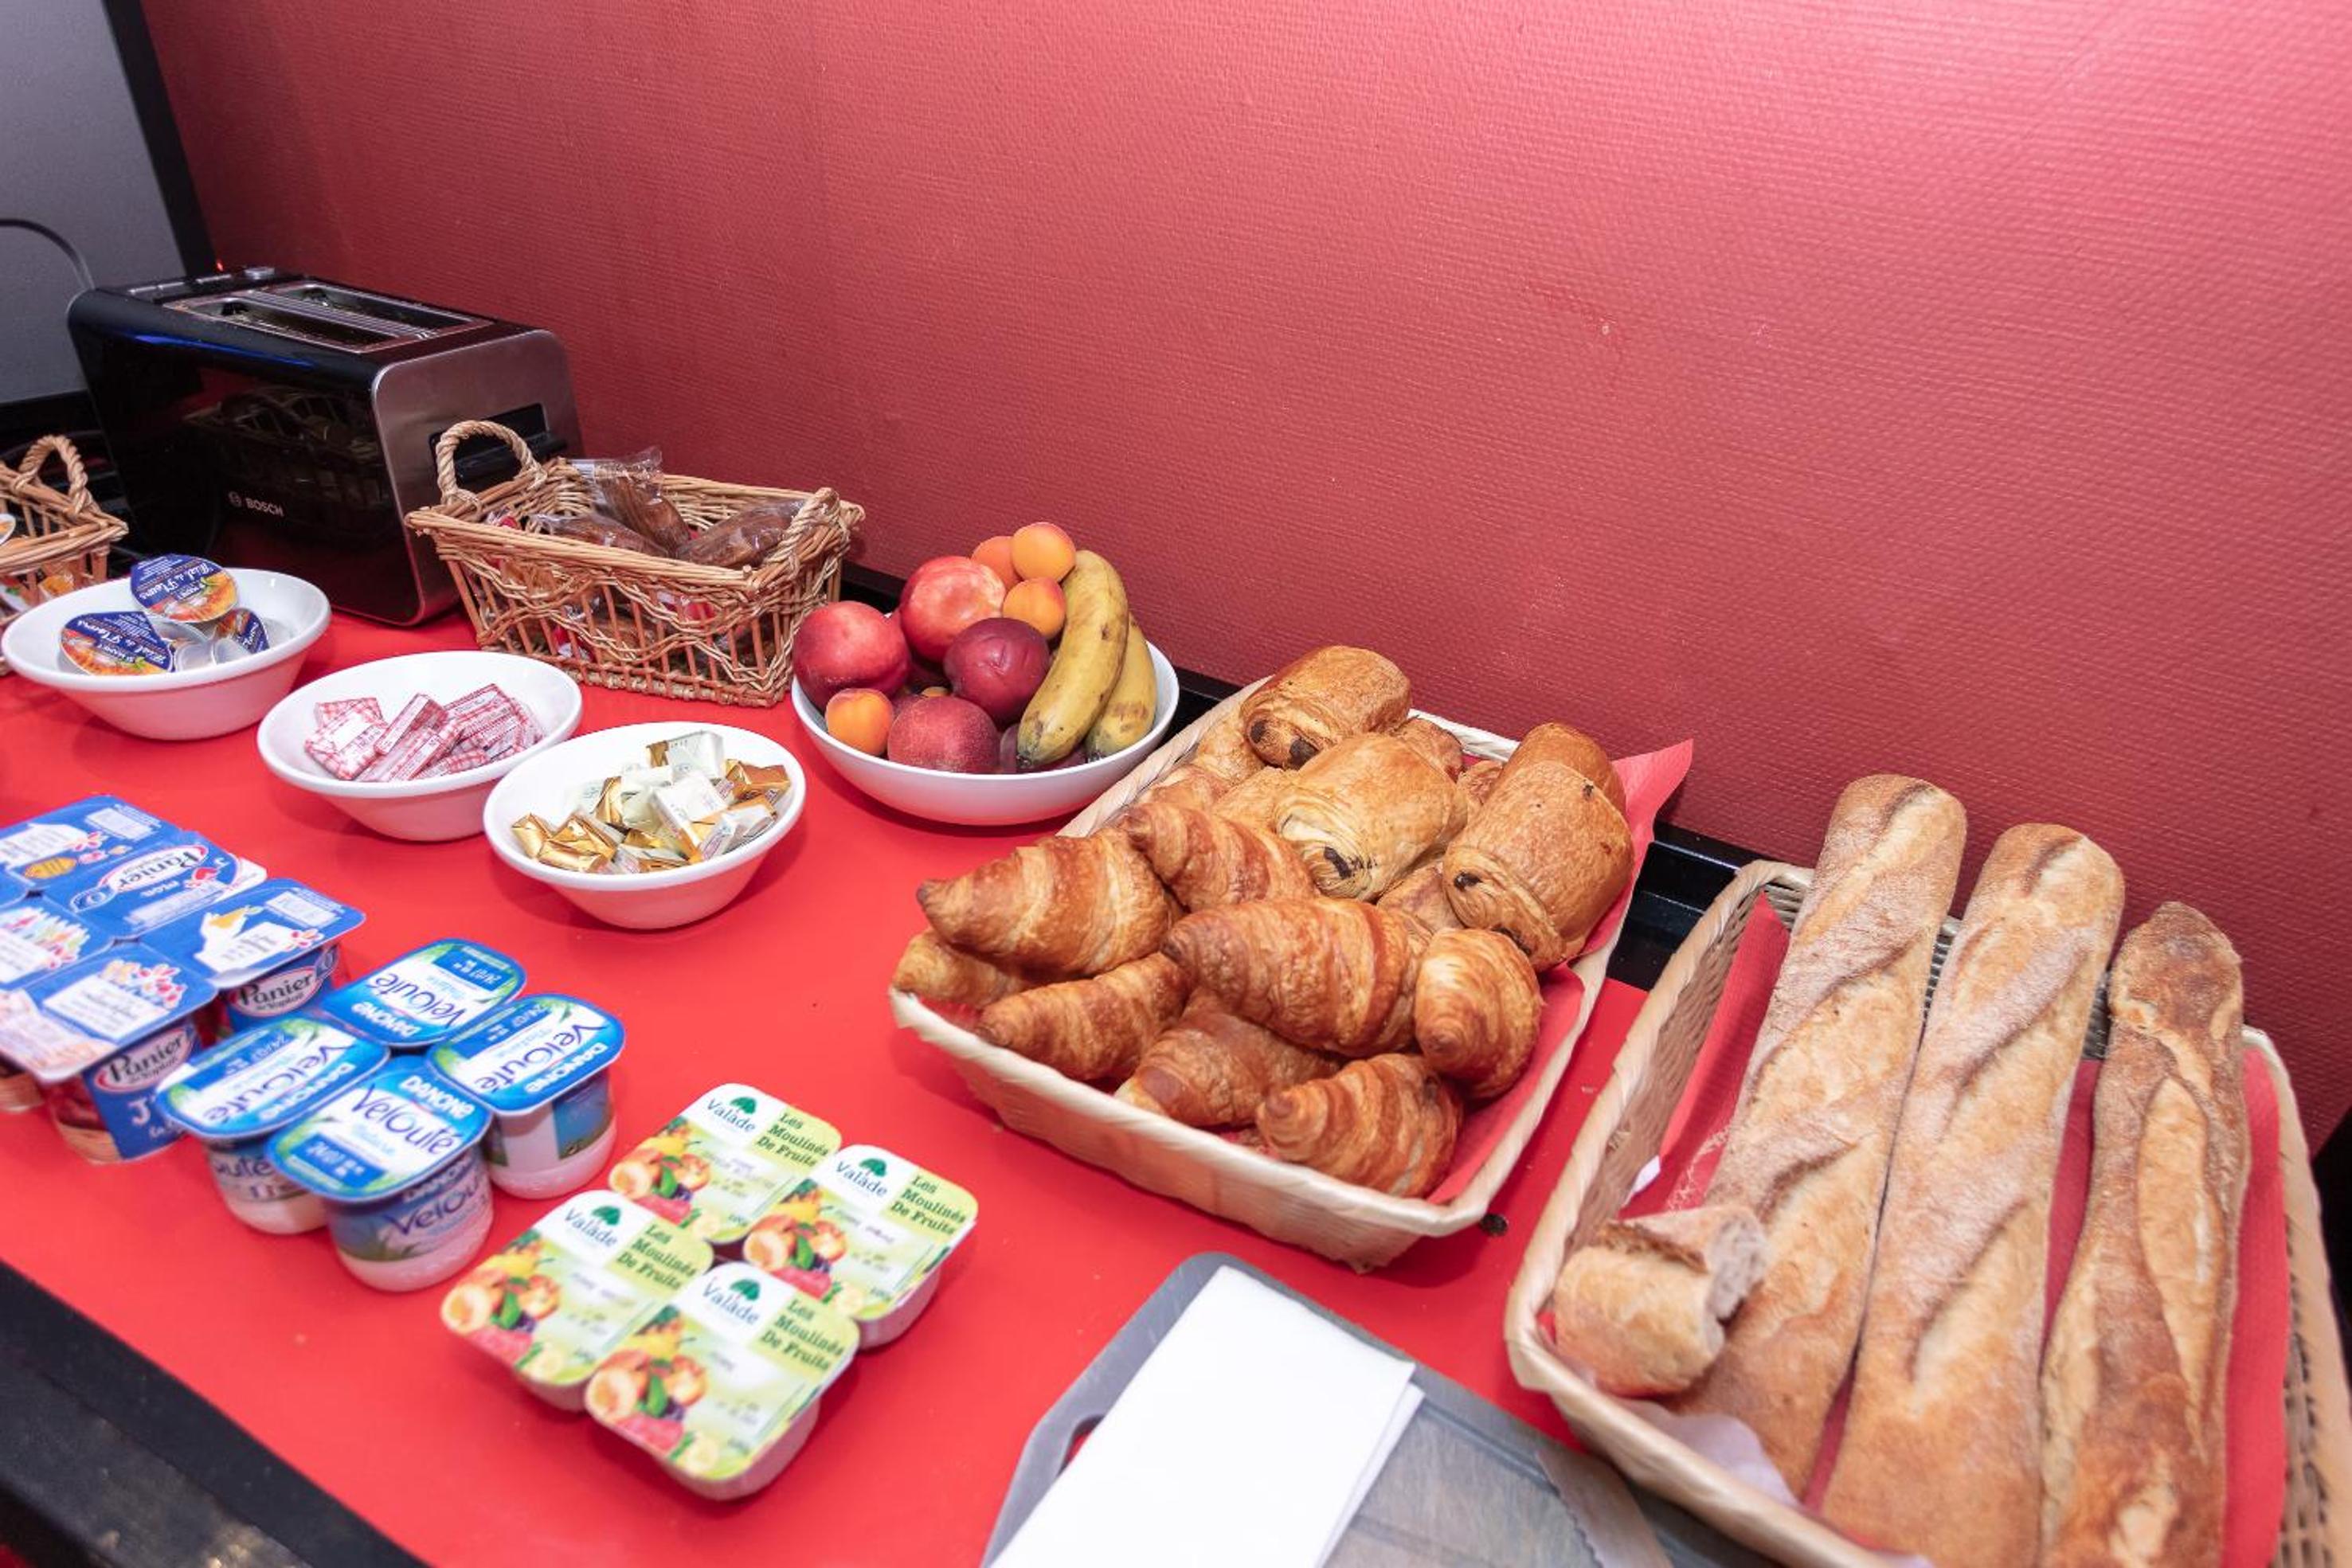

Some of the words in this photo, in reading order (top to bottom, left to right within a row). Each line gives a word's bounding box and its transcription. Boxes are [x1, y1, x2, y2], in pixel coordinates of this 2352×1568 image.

[245, 497, 284, 518] BOSCH
[118, 850, 199, 887] Panier
[240, 973, 314, 1007] Panier
[109, 1037, 182, 1082] Panier
[707, 1098, 755, 1132] Valade
[779, 1112, 804, 1129] Les
[757, 1136, 775, 1150] De
[775, 1145, 816, 1167] Fruits
[836, 1161, 888, 1197] Valade
[911, 1175, 937, 1194] Les
[890, 1201, 910, 1215] De
[911, 1211, 956, 1234] Fruits
[645, 1224, 671, 1245] Les
[637, 1263, 681, 1290] Fruits
[787, 1299, 815, 1321] Les
[784, 1342, 831, 1371] Fruits
